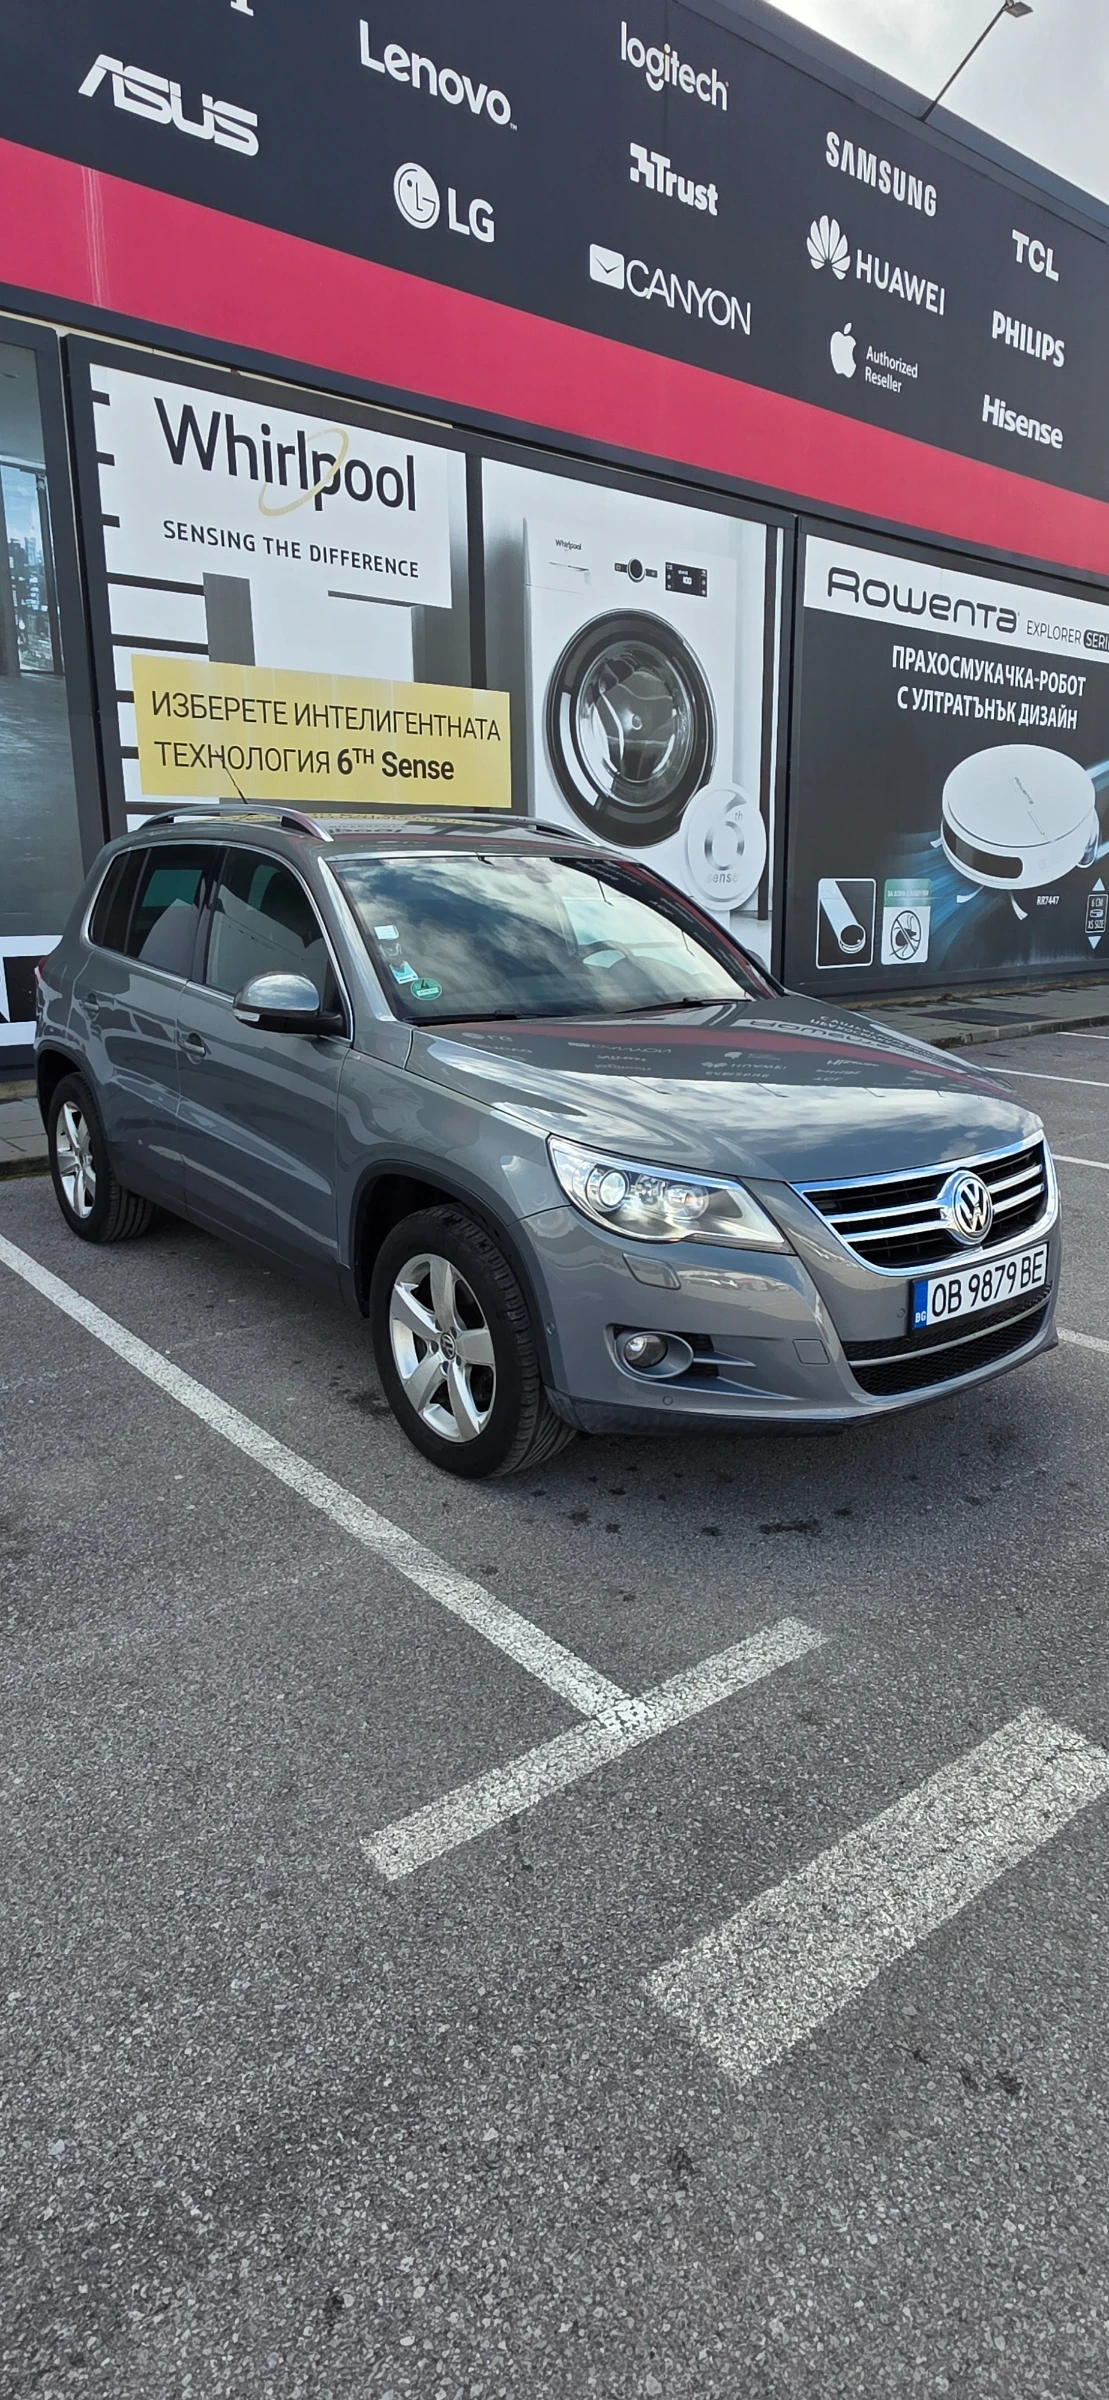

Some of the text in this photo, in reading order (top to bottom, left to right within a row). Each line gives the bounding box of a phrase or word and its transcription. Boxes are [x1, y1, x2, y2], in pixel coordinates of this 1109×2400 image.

[360, 19, 511, 125] Lenovo
[621, 21, 728, 111] logitech
[78, 54, 259, 156] ASUS
[651, 151, 718, 216] Trust
[826, 131, 937, 217] SAMSUNG
[448, 187, 495, 243] LG
[857, 249, 945, 316] HUAWEI
[1012, 229, 1059, 282] TCL
[626, 260, 751, 335] CANYON
[866, 345, 918, 379] Authorized
[992, 310, 1065, 368] PHILIPS
[865, 366, 902, 393] Reseller
[982, 395, 1063, 449] Hisense
[154, 397, 416, 512] Whirlpool
[163, 520, 419, 578] SENSING THE DIFFERENCE
[555, 539, 582, 551] Whirlpool
[1026, 619, 1109, 651] EXPLORER SERI
[892, 644, 1087, 697] ПРАХОСМУКАЧКА-РОБОТ
[152, 690, 501, 742] ИЗБЕРЕТЕ ИНТЕЛИГЕНТНАТА
[897, 685, 1079, 731] С УЛТРАТЪНЪК ДИЗАЙН
[153, 740, 331, 775] ТЕХНОЛОГИЯ
[381, 751, 455, 781] Sense
[931, 1250, 1044, 1317] OB 9879 BE
[915, 1311, 927, 1323] BG
